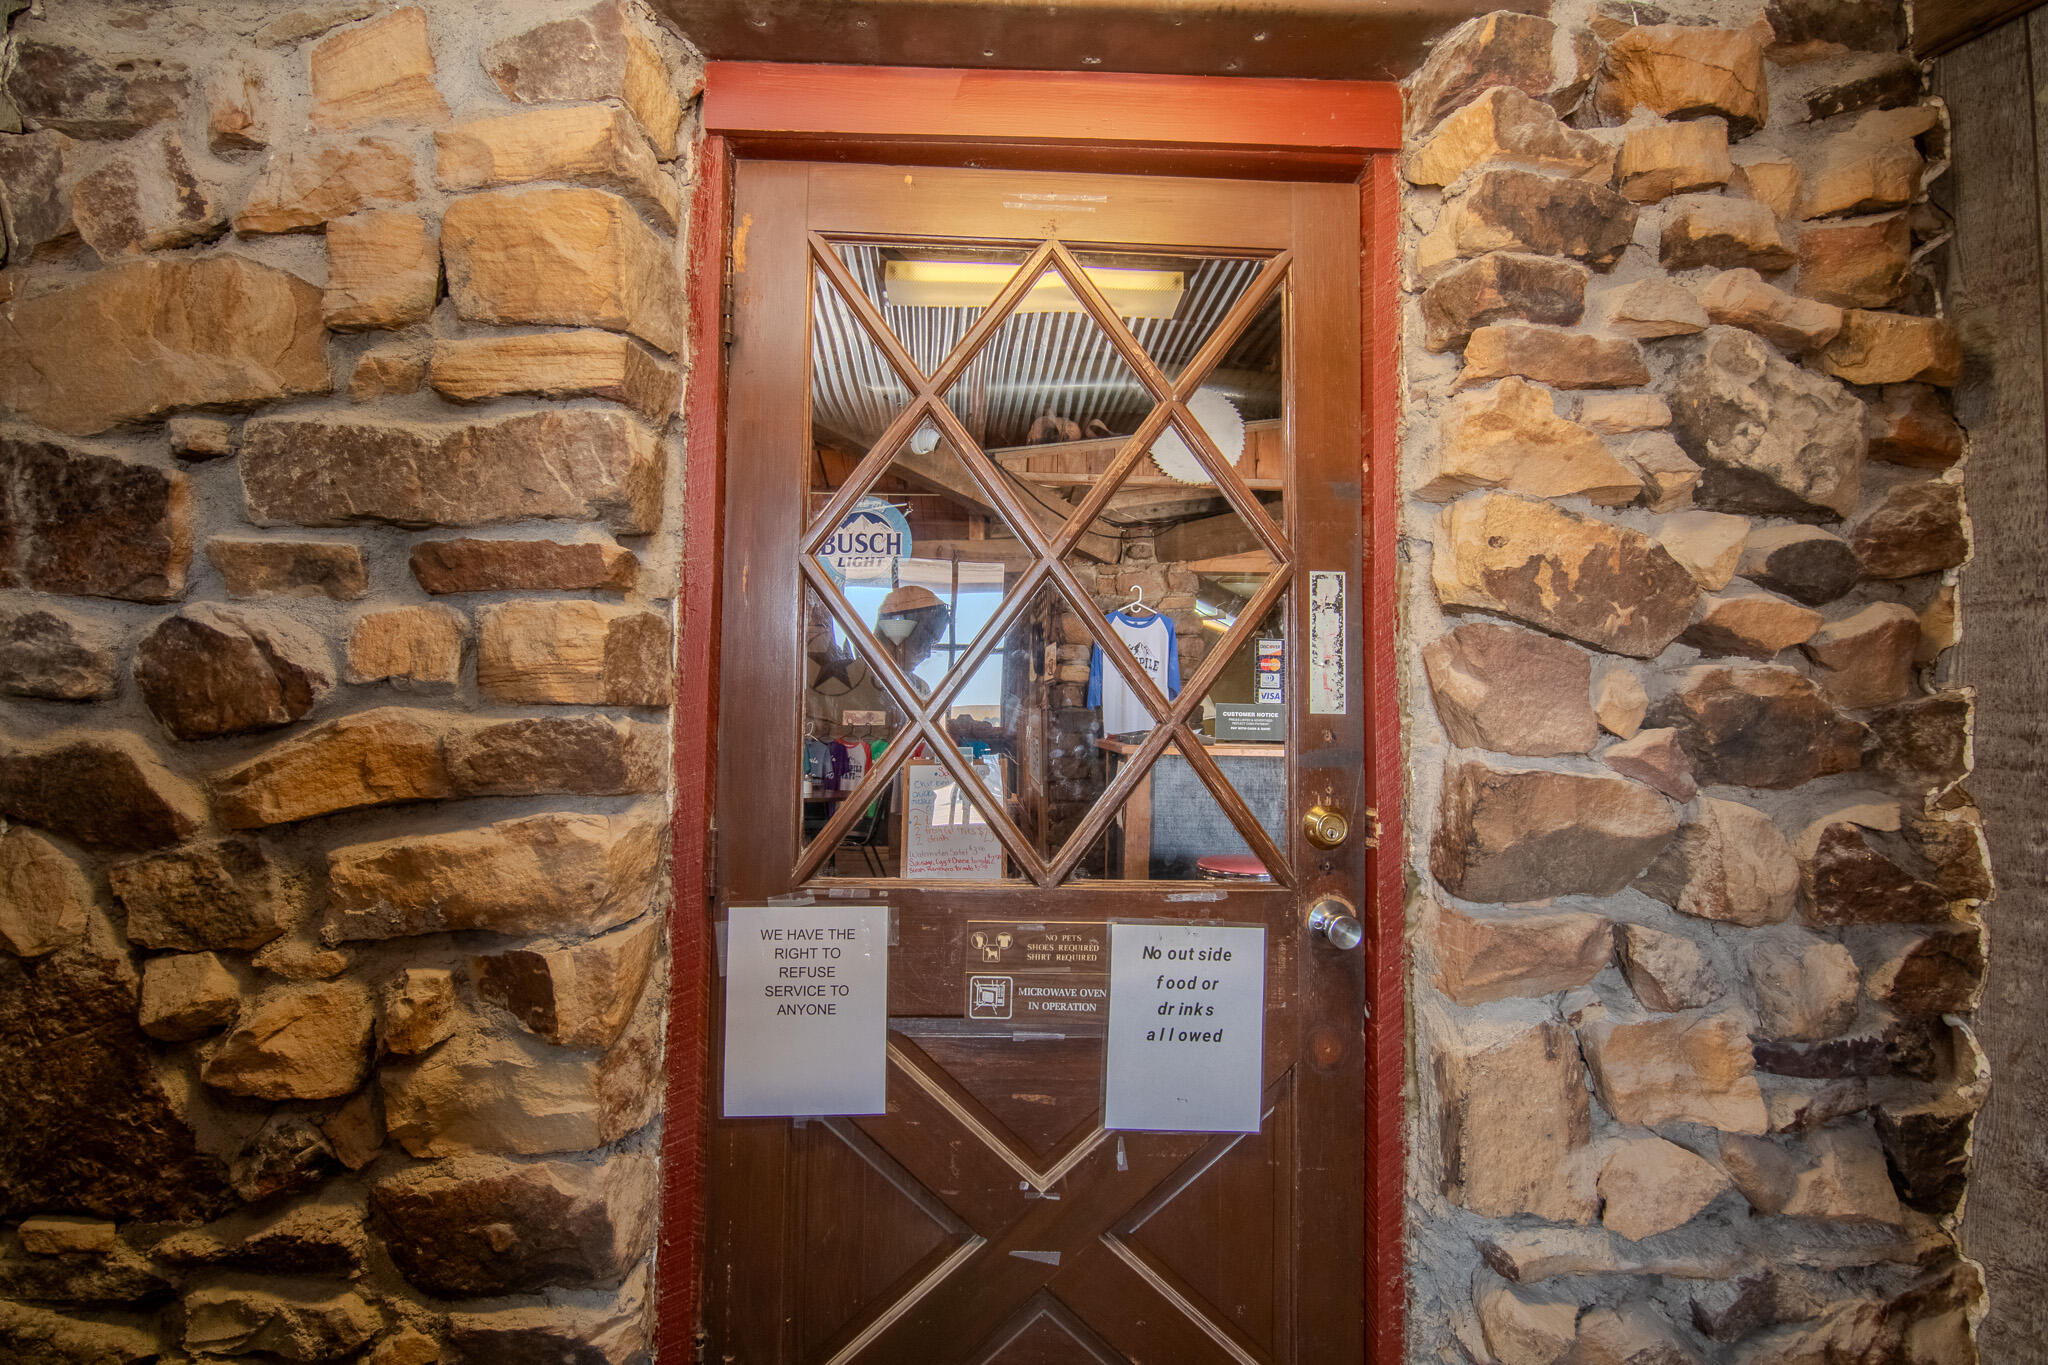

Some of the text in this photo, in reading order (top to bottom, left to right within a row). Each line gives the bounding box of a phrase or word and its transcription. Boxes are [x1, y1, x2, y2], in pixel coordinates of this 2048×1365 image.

[820, 532, 901, 555] BUSCH
[837, 556, 884, 567] LIGHT
[1261, 692, 1281, 700] VISA
[760, 928, 856, 941] WE HAVE THE
[1045, 934, 1082, 942] NO PETS
[774, 947, 842, 960] RIGHT TO
[1026, 943, 1100, 952] SHOES REQUIRED
[1142, 945, 1162, 960] No
[1026, 953, 1098, 962] SHIRT REQUIRED
[778, 965, 836, 979] REFUSE
[1156, 974, 1220, 991] food or
[764, 984, 850, 998] SERVICE TO
[1018, 987, 1107, 998] MICROWAVE OVEN
[776, 1003, 837, 1016] ANYONE
[1028, 1001, 1097, 1012] IN OPERATION
[1157, 1001, 1215, 1017] drinks
[1146, 1027, 1224, 1043] allowed
